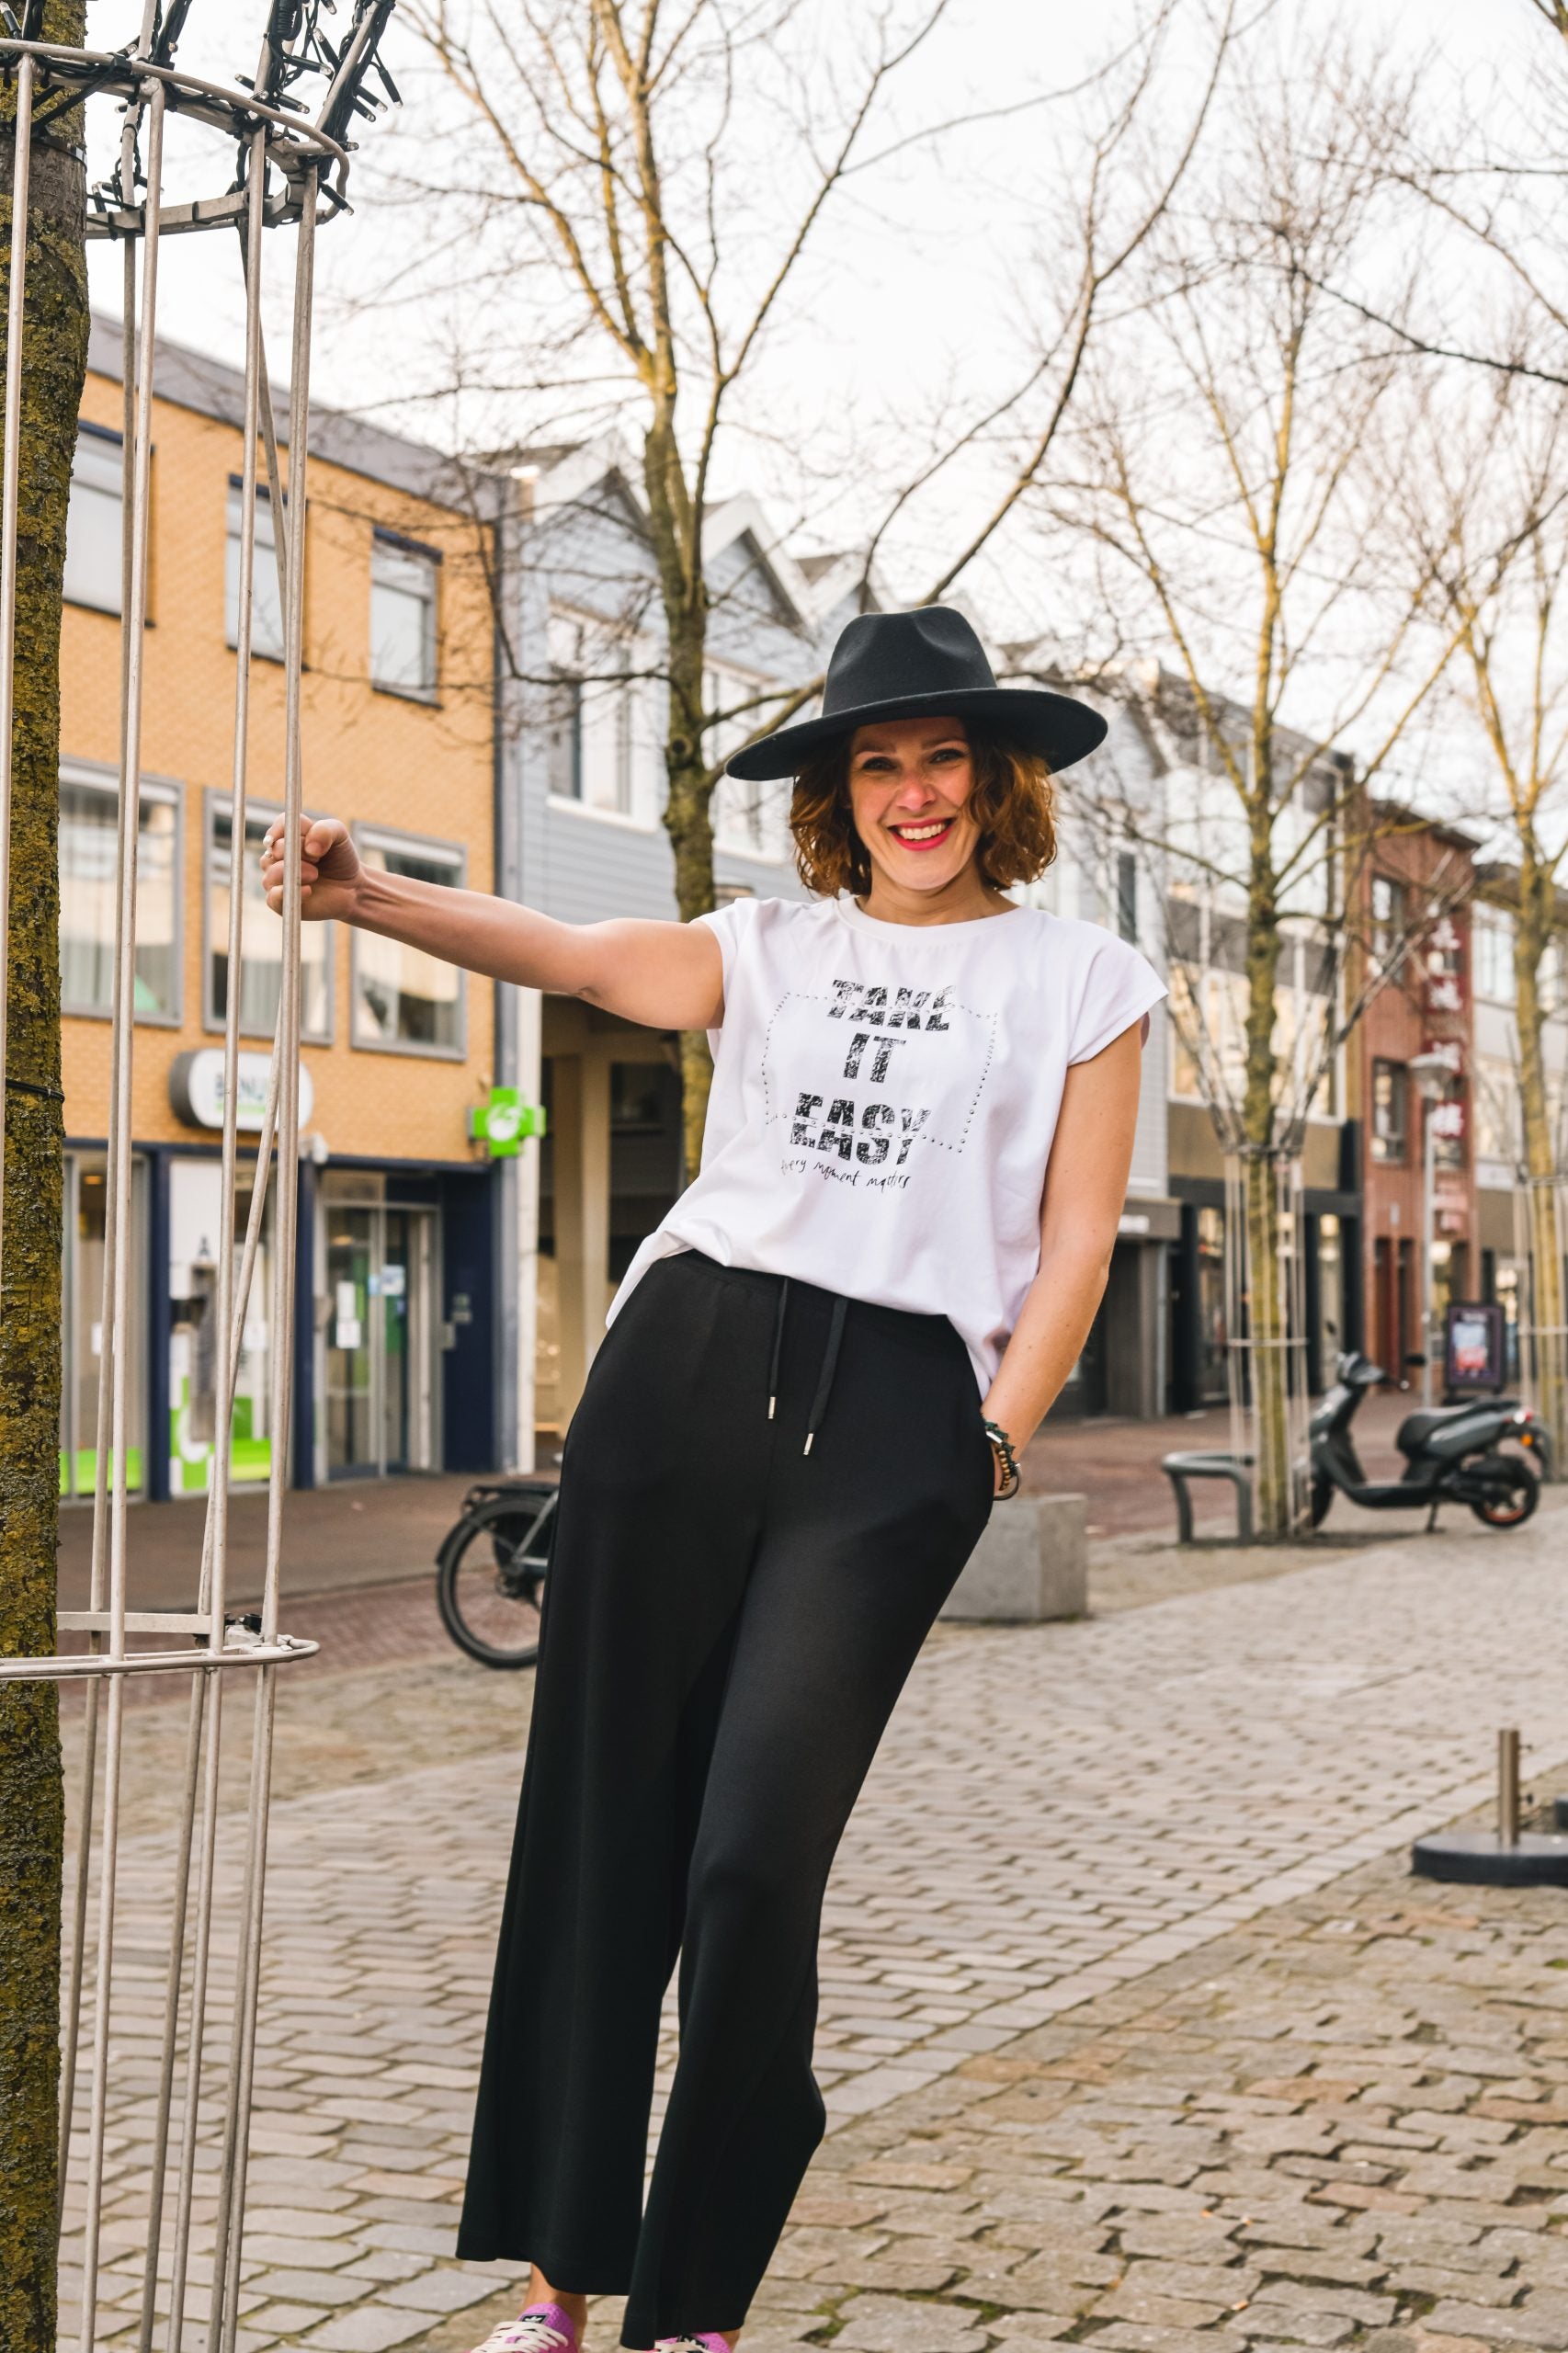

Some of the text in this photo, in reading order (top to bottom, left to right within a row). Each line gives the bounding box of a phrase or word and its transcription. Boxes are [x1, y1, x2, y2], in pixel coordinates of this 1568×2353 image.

[827, 979, 956, 1031] TAKE
[843, 1032, 906, 1083] IT
[790, 1092, 931, 1165] EASY
[812, 1161, 861, 1187] moment
